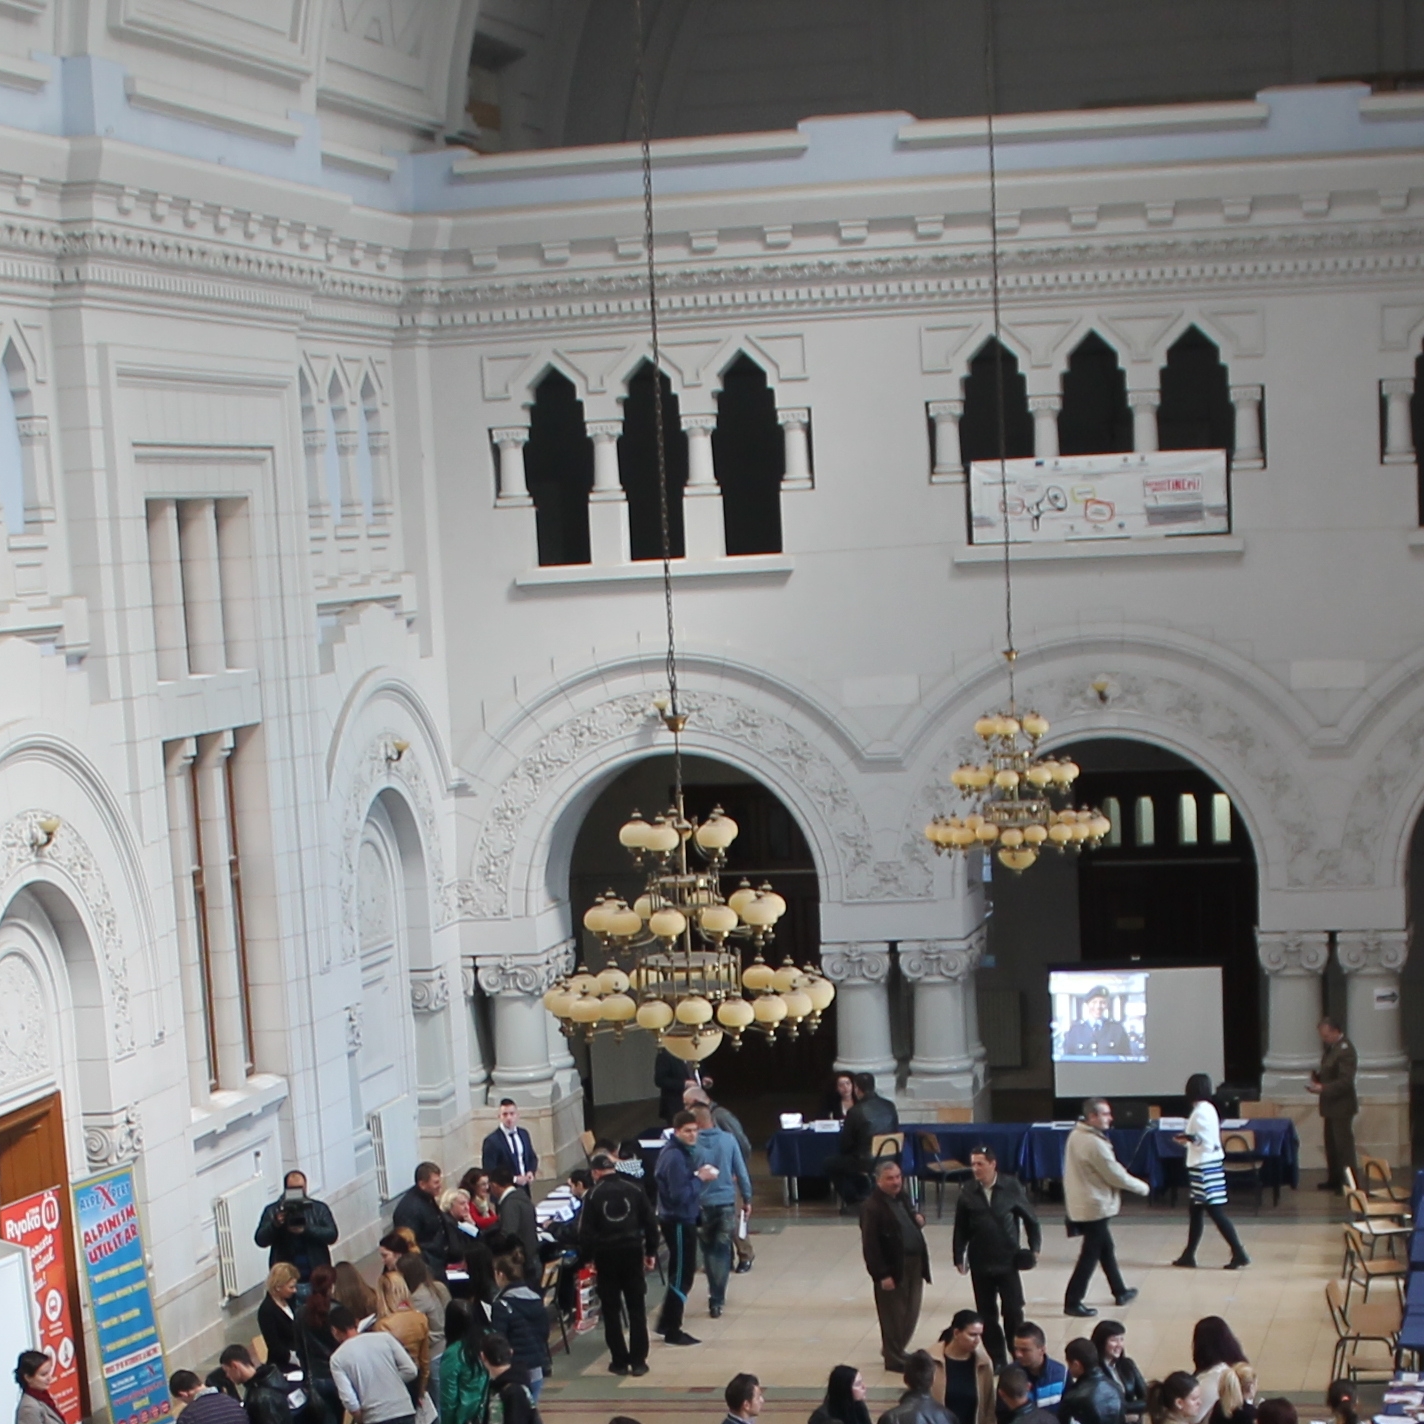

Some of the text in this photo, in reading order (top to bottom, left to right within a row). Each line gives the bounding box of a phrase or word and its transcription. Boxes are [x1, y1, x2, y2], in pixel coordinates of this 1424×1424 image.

[5, 1211, 41, 1242] Ryoko
[83, 1204, 137, 1248] ALPINISM
[87, 1223, 139, 1264] UTILITAR
